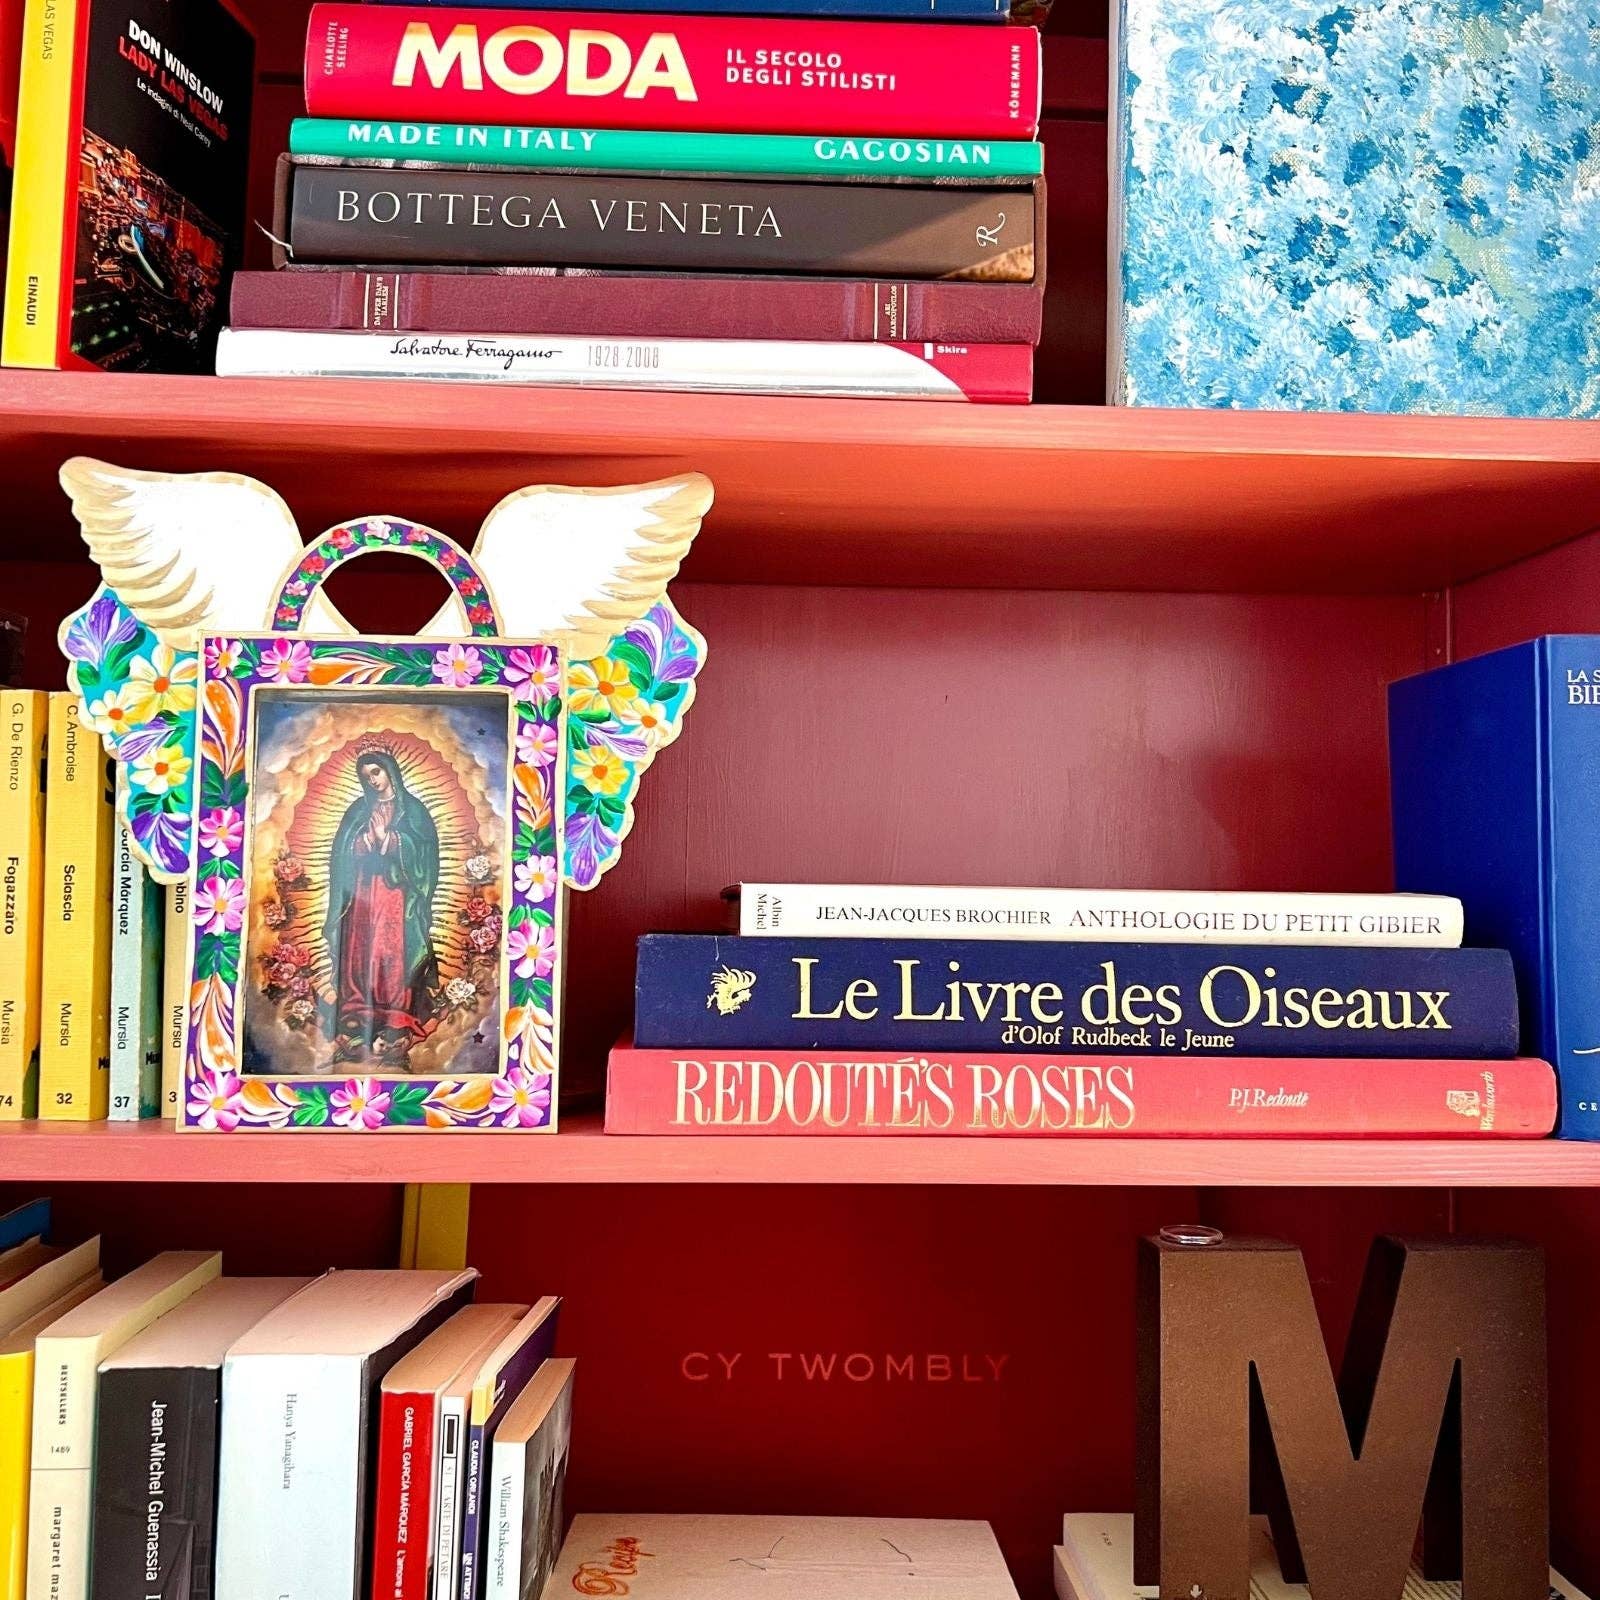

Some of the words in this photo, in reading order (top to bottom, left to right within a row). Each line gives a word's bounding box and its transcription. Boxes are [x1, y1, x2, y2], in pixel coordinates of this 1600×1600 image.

[42, 23, 54, 60] VEGAS
[324, 21, 338, 76] CHARLOTTE
[336, 27, 349, 69] SEELING
[392, 22, 698, 102] MODA
[726, 48, 746, 65] IL
[755, 50, 842, 69] SECOLO
[119, 35, 158, 78] LADY
[161, 70, 185, 103] LAS
[188, 94, 229, 141] VEGAS
[129, 19, 161, 60] DON
[164, 48, 224, 114] WINSLOW
[726, 68, 792, 86] DEGLI
[800, 71, 896, 91] STILISTI
[1009, 44, 1021, 119] KÖNEMANN
[136, 77, 147, 92] Le
[147, 85, 173, 113] indagini
[349, 123, 442, 145] MADE
[455, 127, 488, 148] IN
[503, 129, 598, 152] ITALY
[813, 138, 991, 165] GAGOSIAN
[336, 190, 567, 230] BOTTEGA
[590, 199, 784, 239] VENETA
[976, 212, 1006, 248] R
[25, 275, 39, 326] EINAUDI
[390, 337, 462, 357] Salvatore
[465, 338, 563, 370] Ferragamo
[936, 345, 968, 355] Skira
[1567, 669, 1589, 683] LA
[11, 702, 24, 718] G.
[11, 722, 24, 741] De
[66, 704, 79, 719] C.
[9, 746, 23, 791] Rienzo
[65, 721, 79, 782] Ambroise
[4, 856, 20, 936] Fogazzaro
[62, 864, 76, 921] Sciascia
[117, 876, 132, 936] Márquez
[756, 893, 769, 930] Michel
[771, 896, 783, 928] Albin
[816, 906, 951, 924] JEAN-JACQUES
[956, 909, 1052, 925] BROCHIER
[1068, 909, 1235, 931] ANTHOLOGIE
[1242, 911, 1279, 932] DU
[1284, 913, 1354, 934] PETIT
[1359, 915, 1443, 935] GIBIER
[791, 957, 879, 1021] Le
[892, 959, 1064, 1024] Livre
[1080, 960, 1183, 1026] des
[1199, 964, 1453, 1031] Oiseaux
[1, 1000, 15, 1046] Mursia
[59, 1003, 73, 1047] Mursia
[116, 1006, 130, 1050] Mursia
[172, 1005, 185, 1049] Mursia
[1001, 1024, 1064, 1046] d'Olof
[1071, 1026, 1152, 1047] Rudbeck
[1160, 1028, 1176, 1048] le
[1181, 1029, 1235, 1052] Jeune
[56, 1092, 73, 1105] 32
[114, 1095, 130, 1108] 37
[965, 1064, 1136, 1130] ROSES
[681, 1352, 742, 1381] CY
[768, 1352, 1010, 1382] TWOMBLY
[59, 1364, 69, 1425] BESTSELLERS
[284, 1393, 298, 1428] Hanya
[149, 1400, 168, 1495] Jean-Michel
[403, 1407, 415, 1451] GABRIEL
[281, 1430, 297, 1490] Yanagihara
[470, 1439, 480, 1477] CLAUDIA
[467, 1477, 478, 1514] ORLANDI
[499, 1475, 512, 1518] William
[50, 1506, 62, 1568] margaret
[145, 1500, 164, 1581] Guenassia
[493, 1521, 511, 1587] Shakespeare
